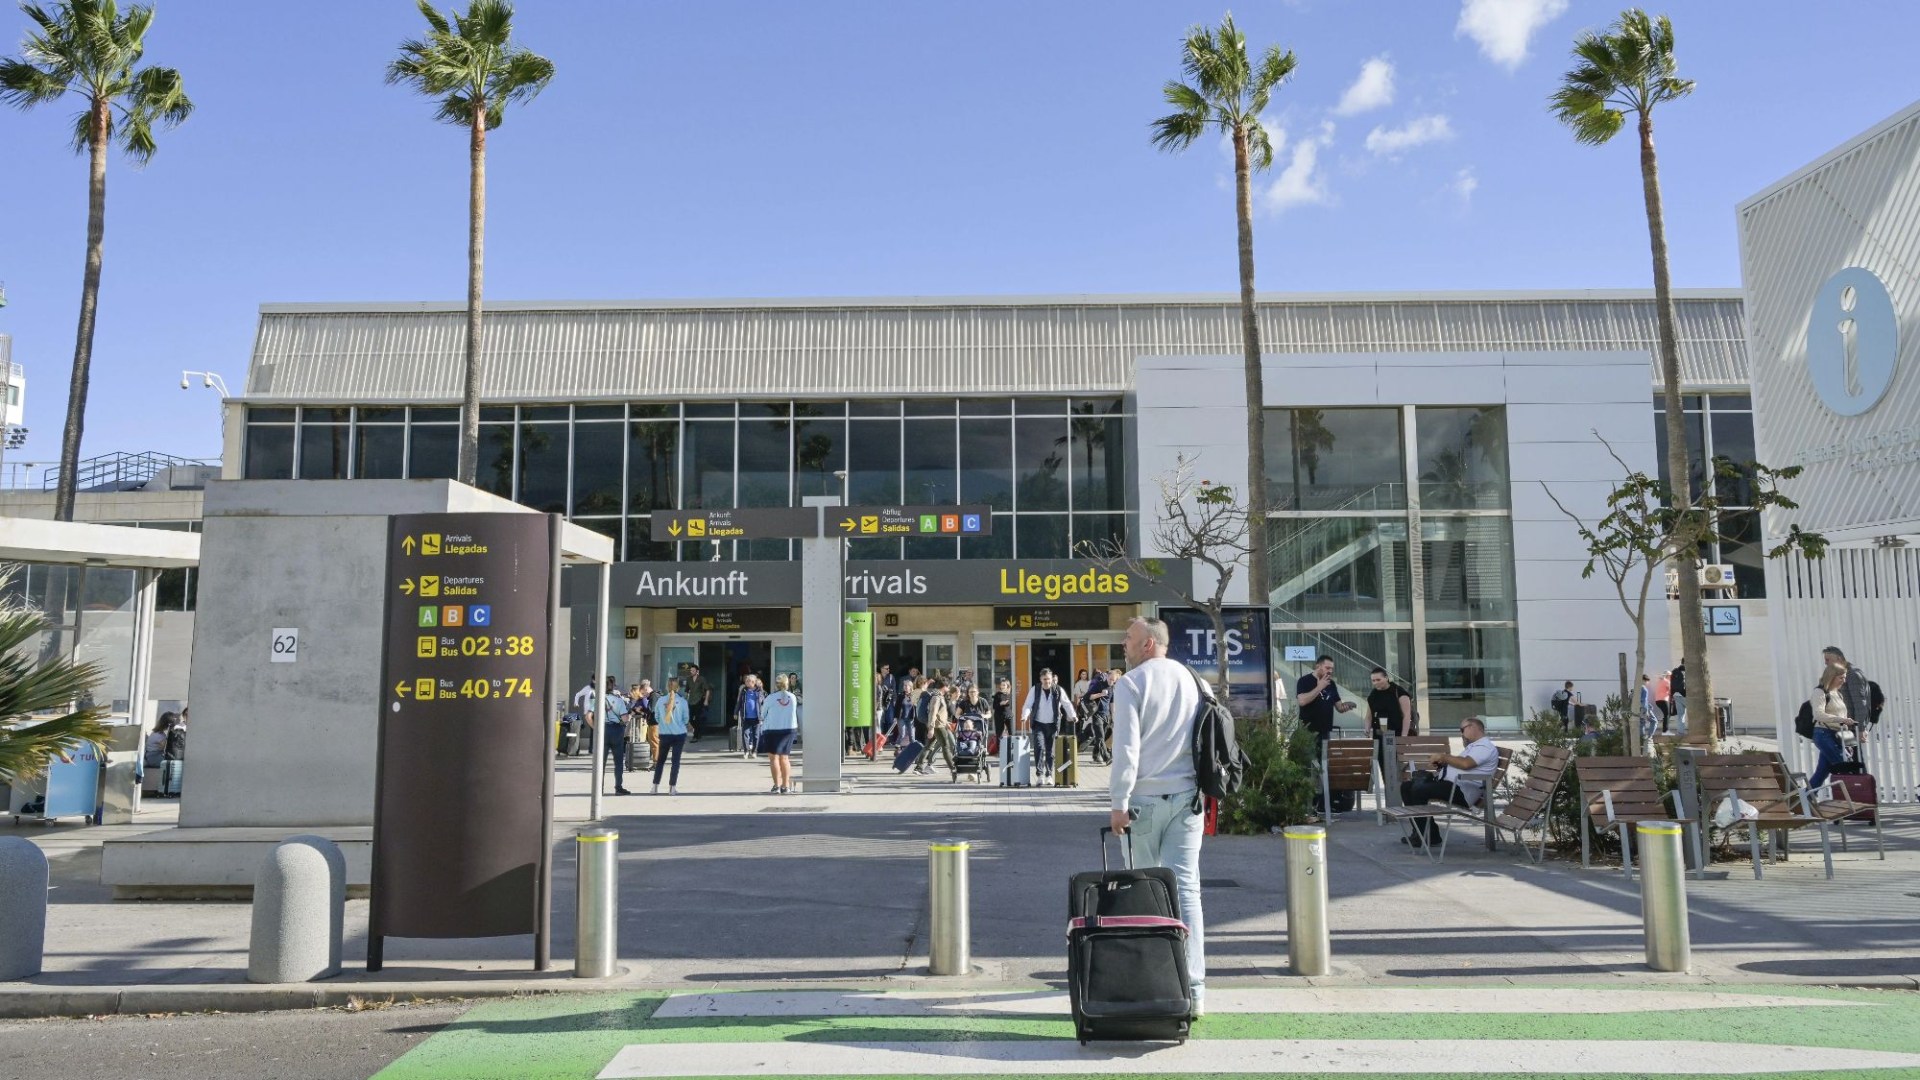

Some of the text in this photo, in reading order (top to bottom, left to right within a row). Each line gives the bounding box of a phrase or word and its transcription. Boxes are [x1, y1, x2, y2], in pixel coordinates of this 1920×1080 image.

[882, 524, 910, 532] Salidas
[923, 517, 976, 529] A B C
[709, 527, 744, 536] Llegadas
[444, 534, 473, 542] Arrivals
[444, 544, 488, 555] Llegadas
[443, 575, 485, 585] Departures
[636, 570, 748, 596] Ankunft
[845, 568, 927, 595] rivals
[1000, 567, 1130, 601] Llegadas
[443, 586, 478, 596] Salidas
[422, 608, 486, 624] A B C
[625, 628, 637, 638] 17
[273, 635, 296, 654] 62
[441, 636, 503, 645] Bus to
[1185, 628, 1244, 656] TFS
[441, 636, 535, 657] Bus 02 a 38
[1186, 658, 1211, 666] Tenerife
[852, 630, 861, 719] Hallo! ¡Hola! Hello!
[439, 679, 502, 688] Bus to
[439, 678, 533, 699] Bus 40 a 74
[80, 753, 95, 761] TUI
